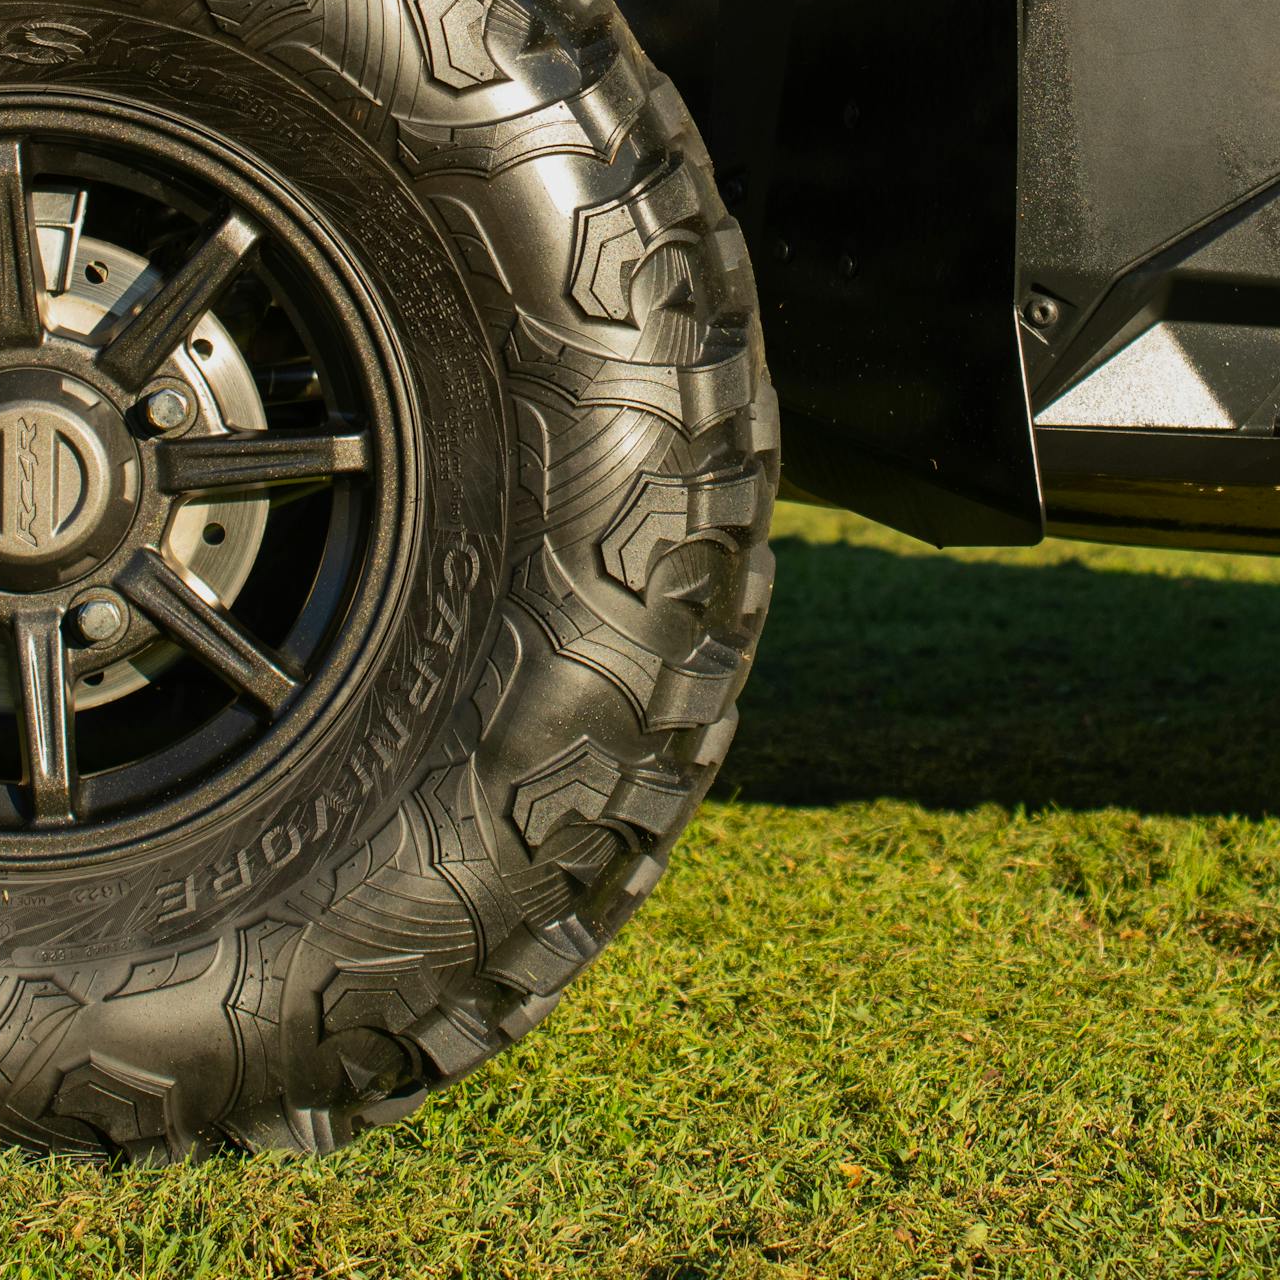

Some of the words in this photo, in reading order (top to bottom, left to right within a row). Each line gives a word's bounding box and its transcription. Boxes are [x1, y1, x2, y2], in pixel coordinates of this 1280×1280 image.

[17, 417, 39, 547] RZR
[156, 543, 482, 924] CARNIVORE
[16, 895, 46, 906] MADE
